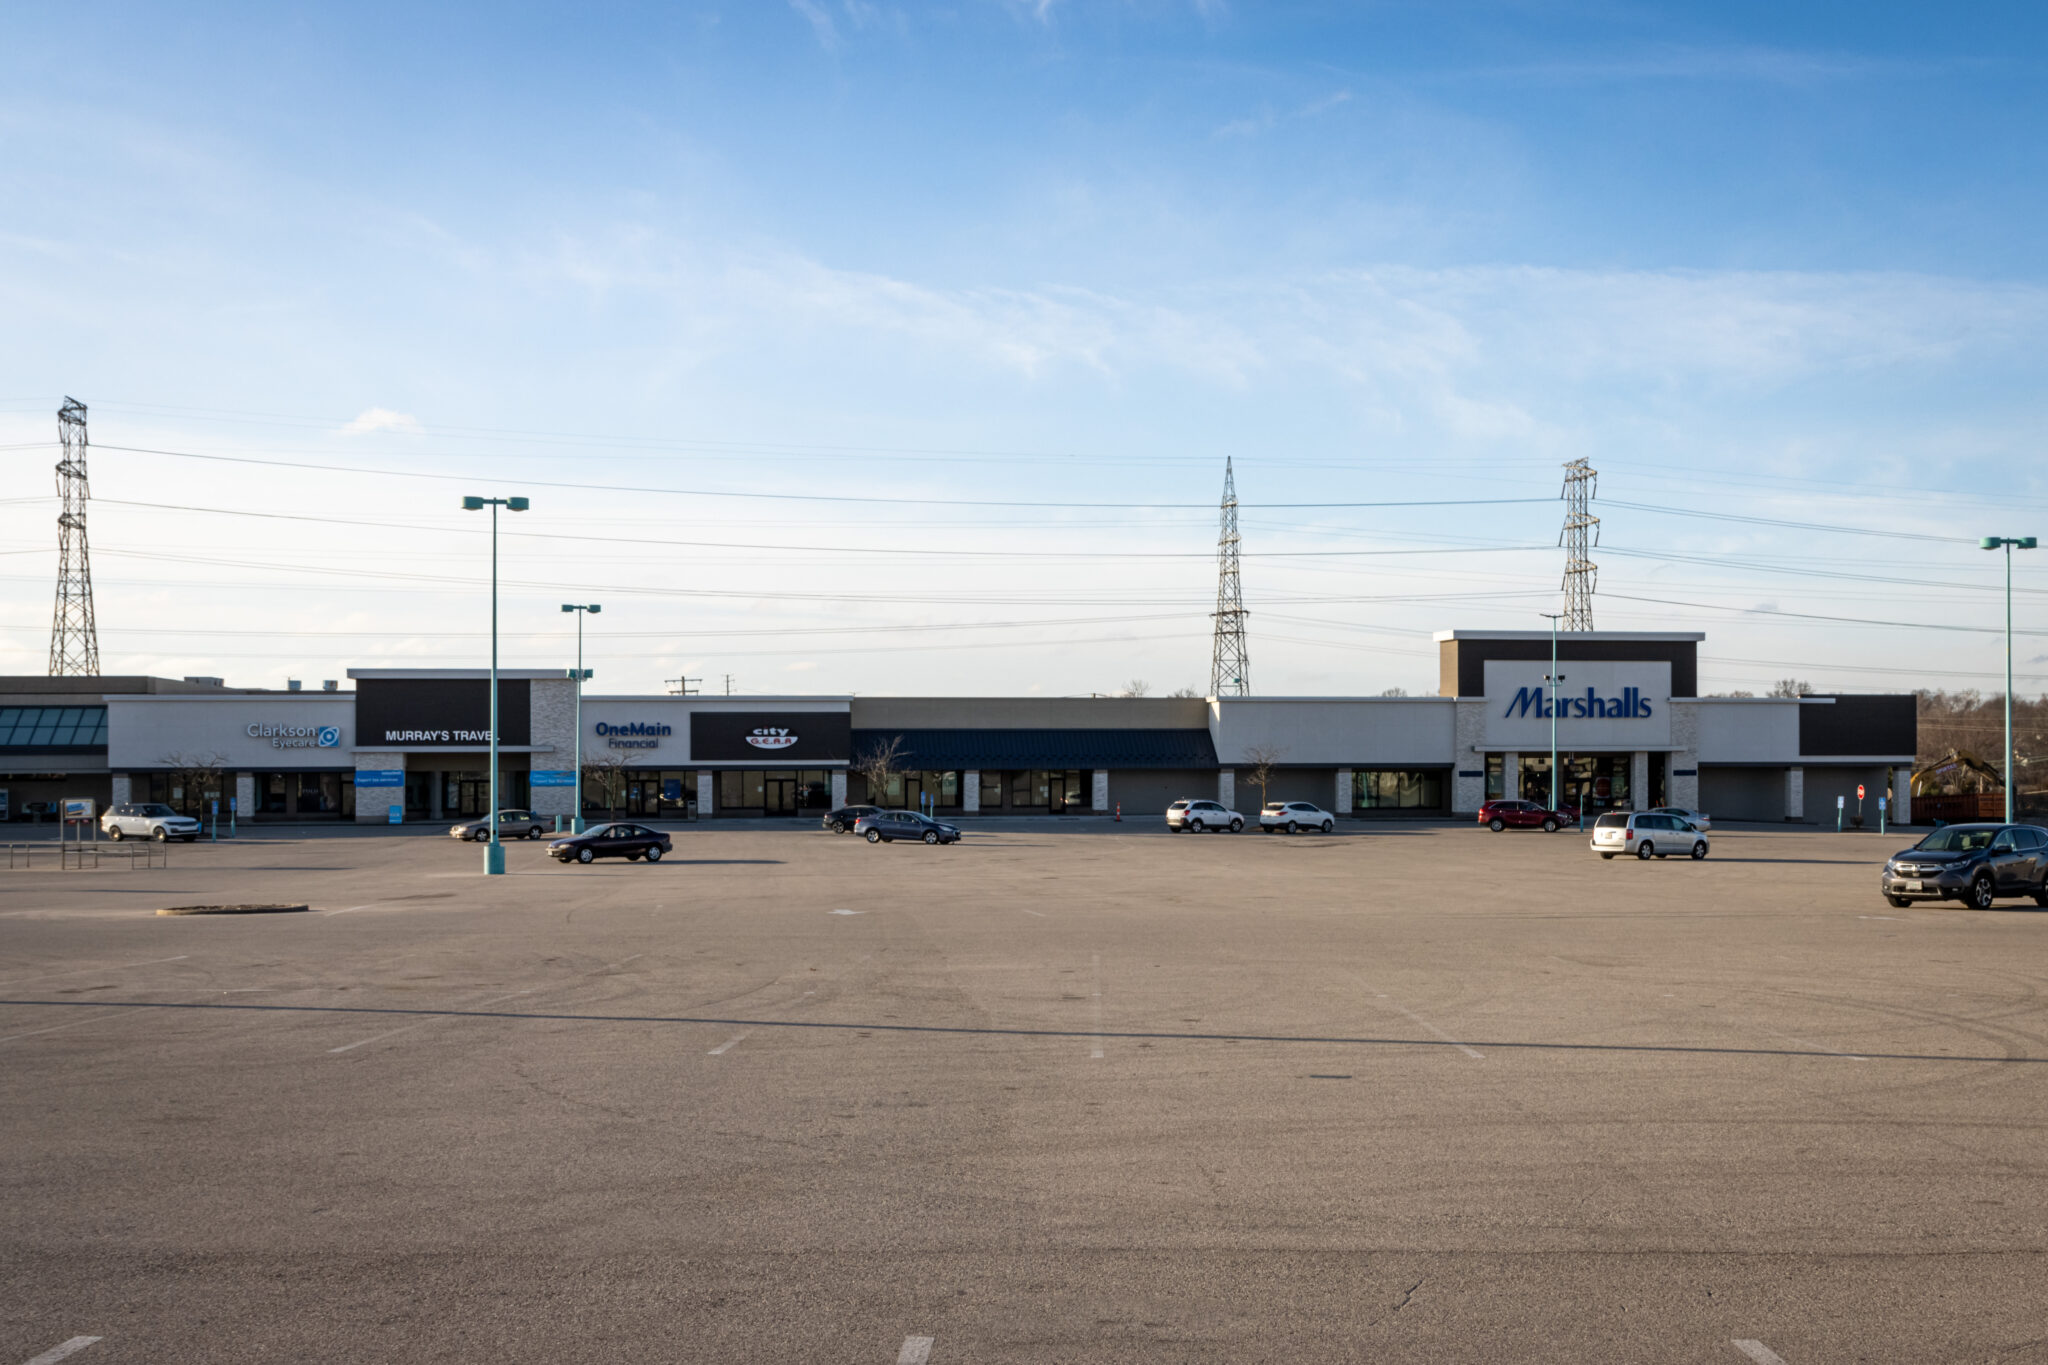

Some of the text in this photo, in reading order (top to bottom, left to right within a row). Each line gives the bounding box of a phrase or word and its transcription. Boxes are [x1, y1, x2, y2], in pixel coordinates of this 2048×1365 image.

[1505, 687, 1652, 718] Marshalls
[247, 722, 316, 737] Clarkson
[595, 722, 671, 736] OneMain
[385, 730, 501, 741] MURRAY'S TRAVE
[272, 738, 315, 749] Eyecare
[608, 737, 658, 748] Financial
